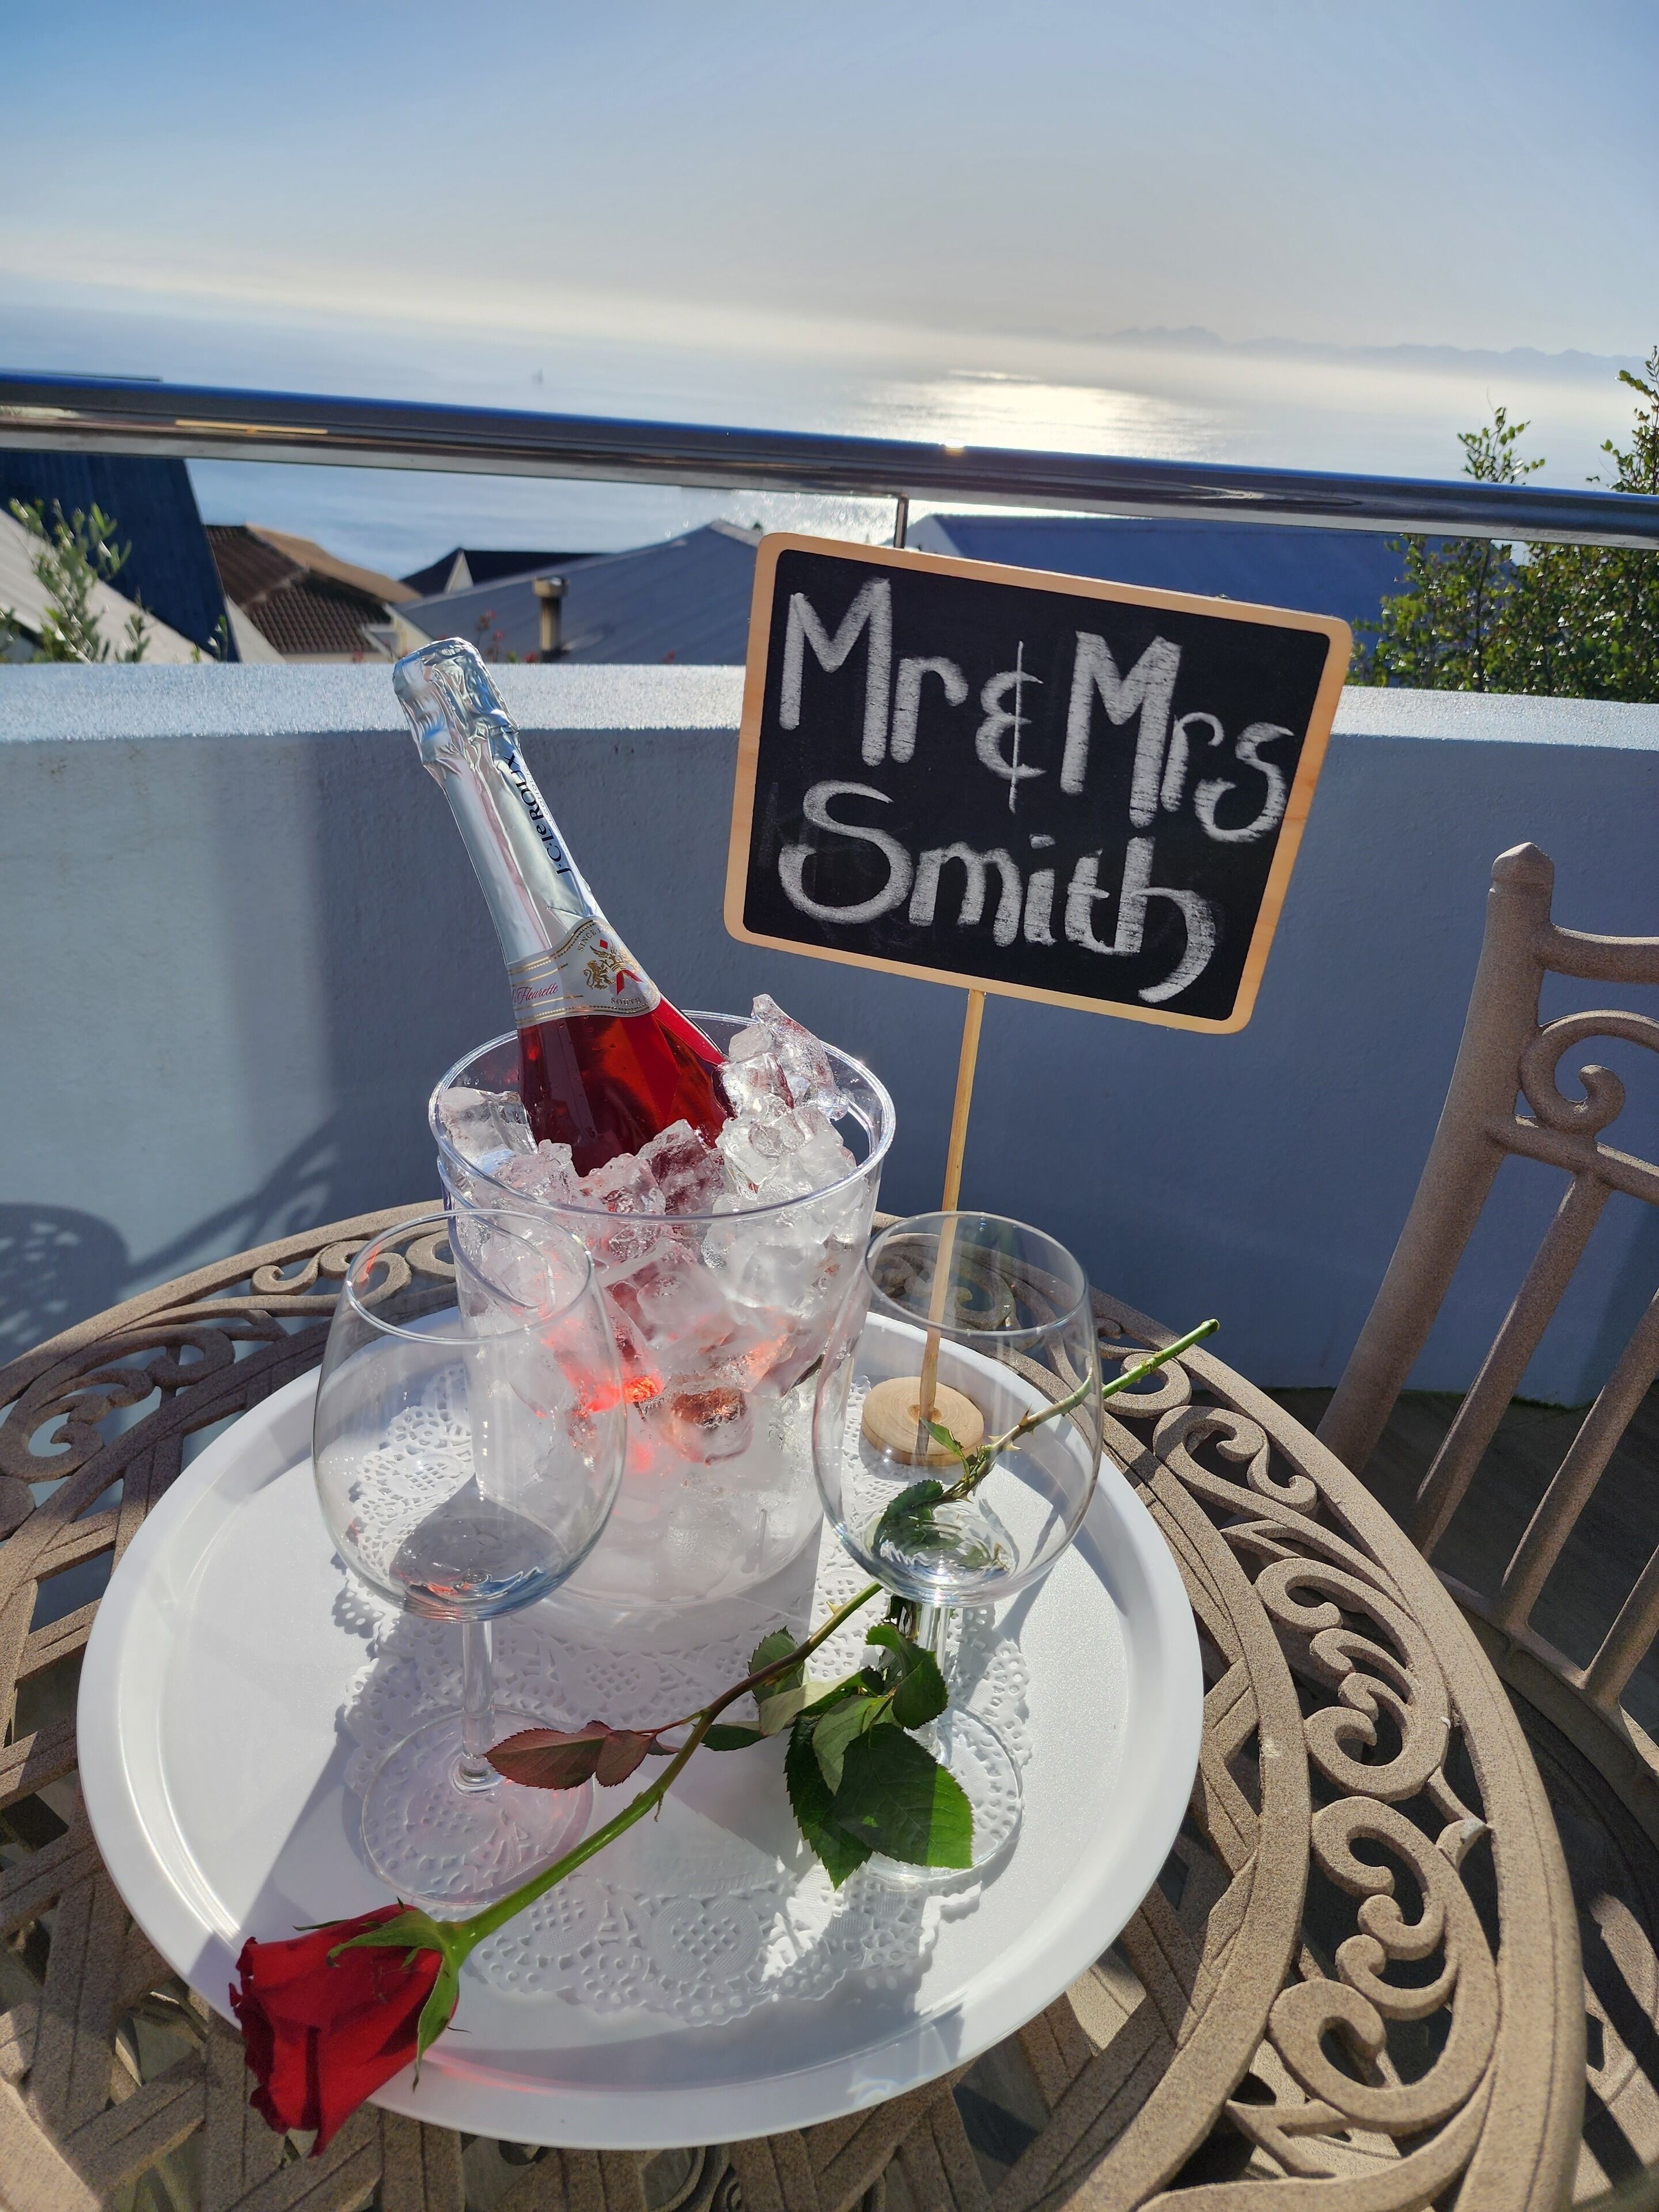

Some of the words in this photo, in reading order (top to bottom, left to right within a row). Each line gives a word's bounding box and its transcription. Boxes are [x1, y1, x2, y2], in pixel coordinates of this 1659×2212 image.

[779, 779, 1217, 1004] Smith
[577, 930, 597, 952] SINCE
[611, 997, 642, 1006] SOUTH
